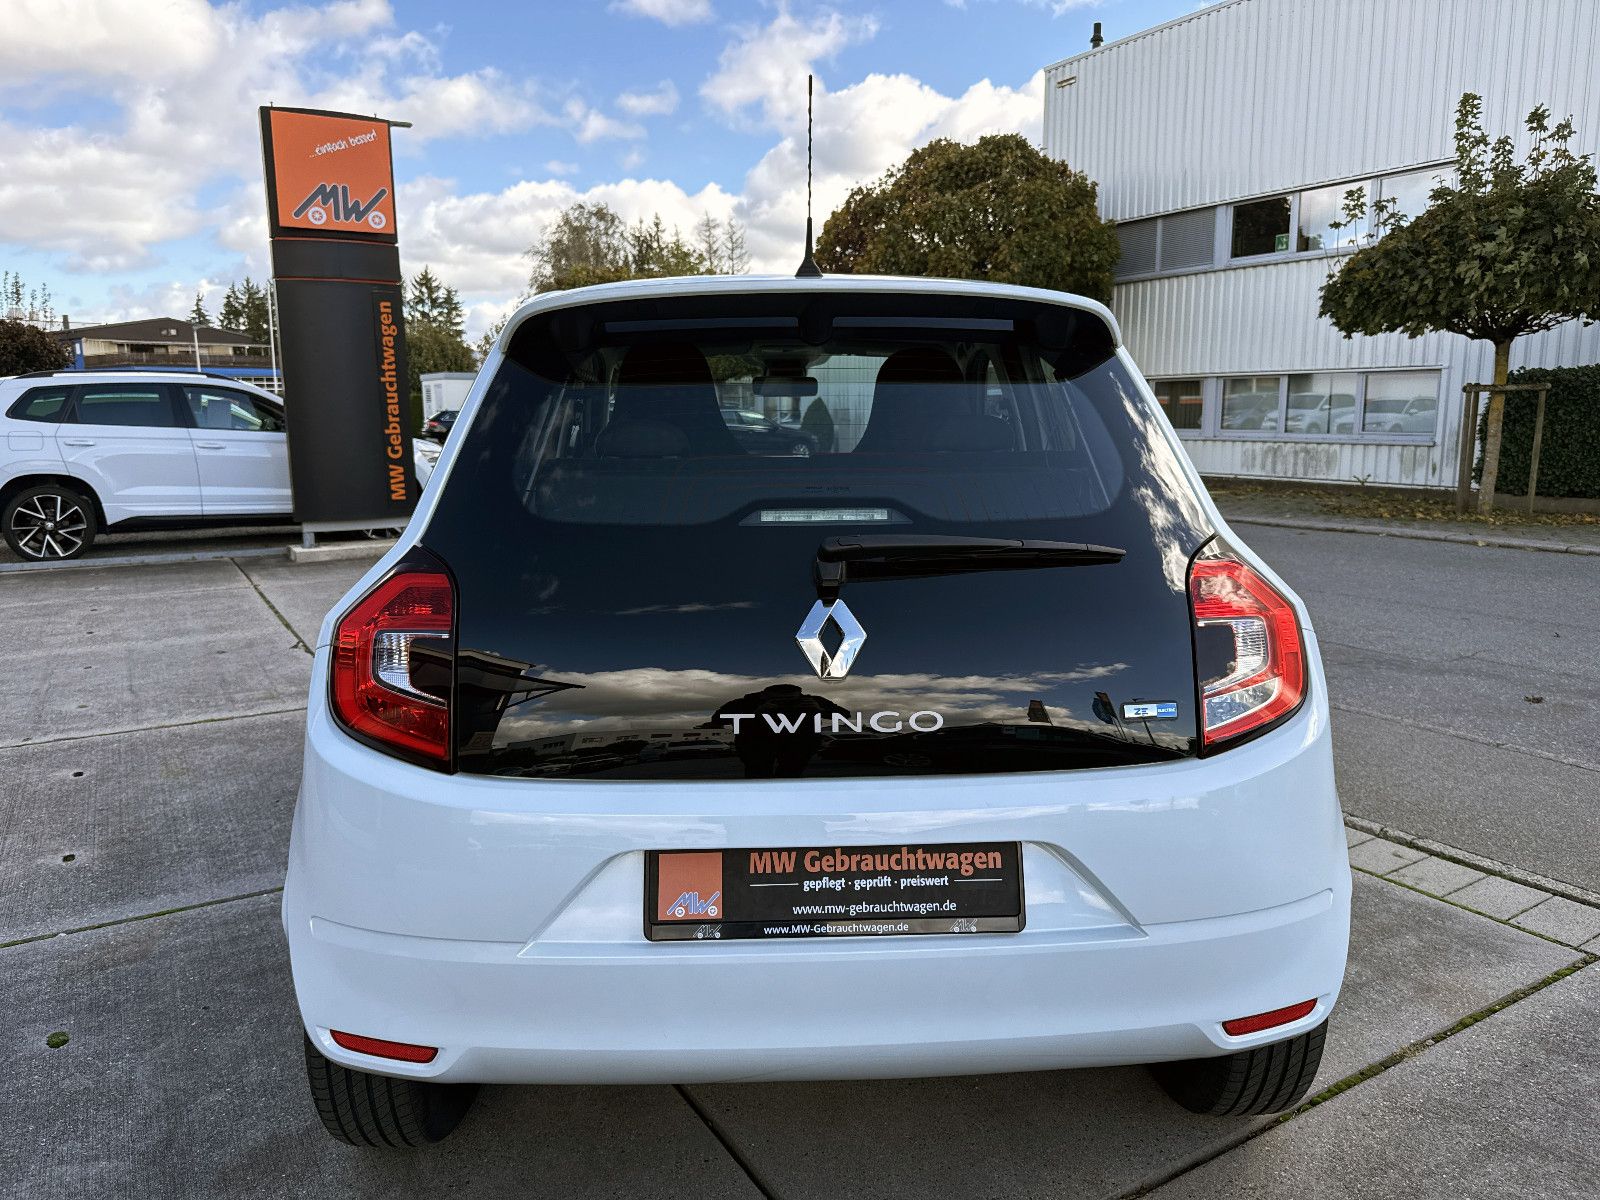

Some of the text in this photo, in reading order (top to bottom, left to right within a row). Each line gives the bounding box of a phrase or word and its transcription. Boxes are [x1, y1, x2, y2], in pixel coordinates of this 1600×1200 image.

[348, 129, 378, 147] besser!
[292, 182, 388, 224] MW
[379, 300, 406, 501] MW Gebrauchtwagen
[719, 710, 944, 735] TWINGO
[750, 847, 1003, 876] MW Gebrauchtwagen
[803, 875, 949, 892] gepflegt geprüft preiswert
[666, 891, 720, 916] MW
[792, 900, 957, 916] www.mw-gebrauchtwagen.de
[763, 922, 909, 936] www.MW-Gebrauchtwagen.de
